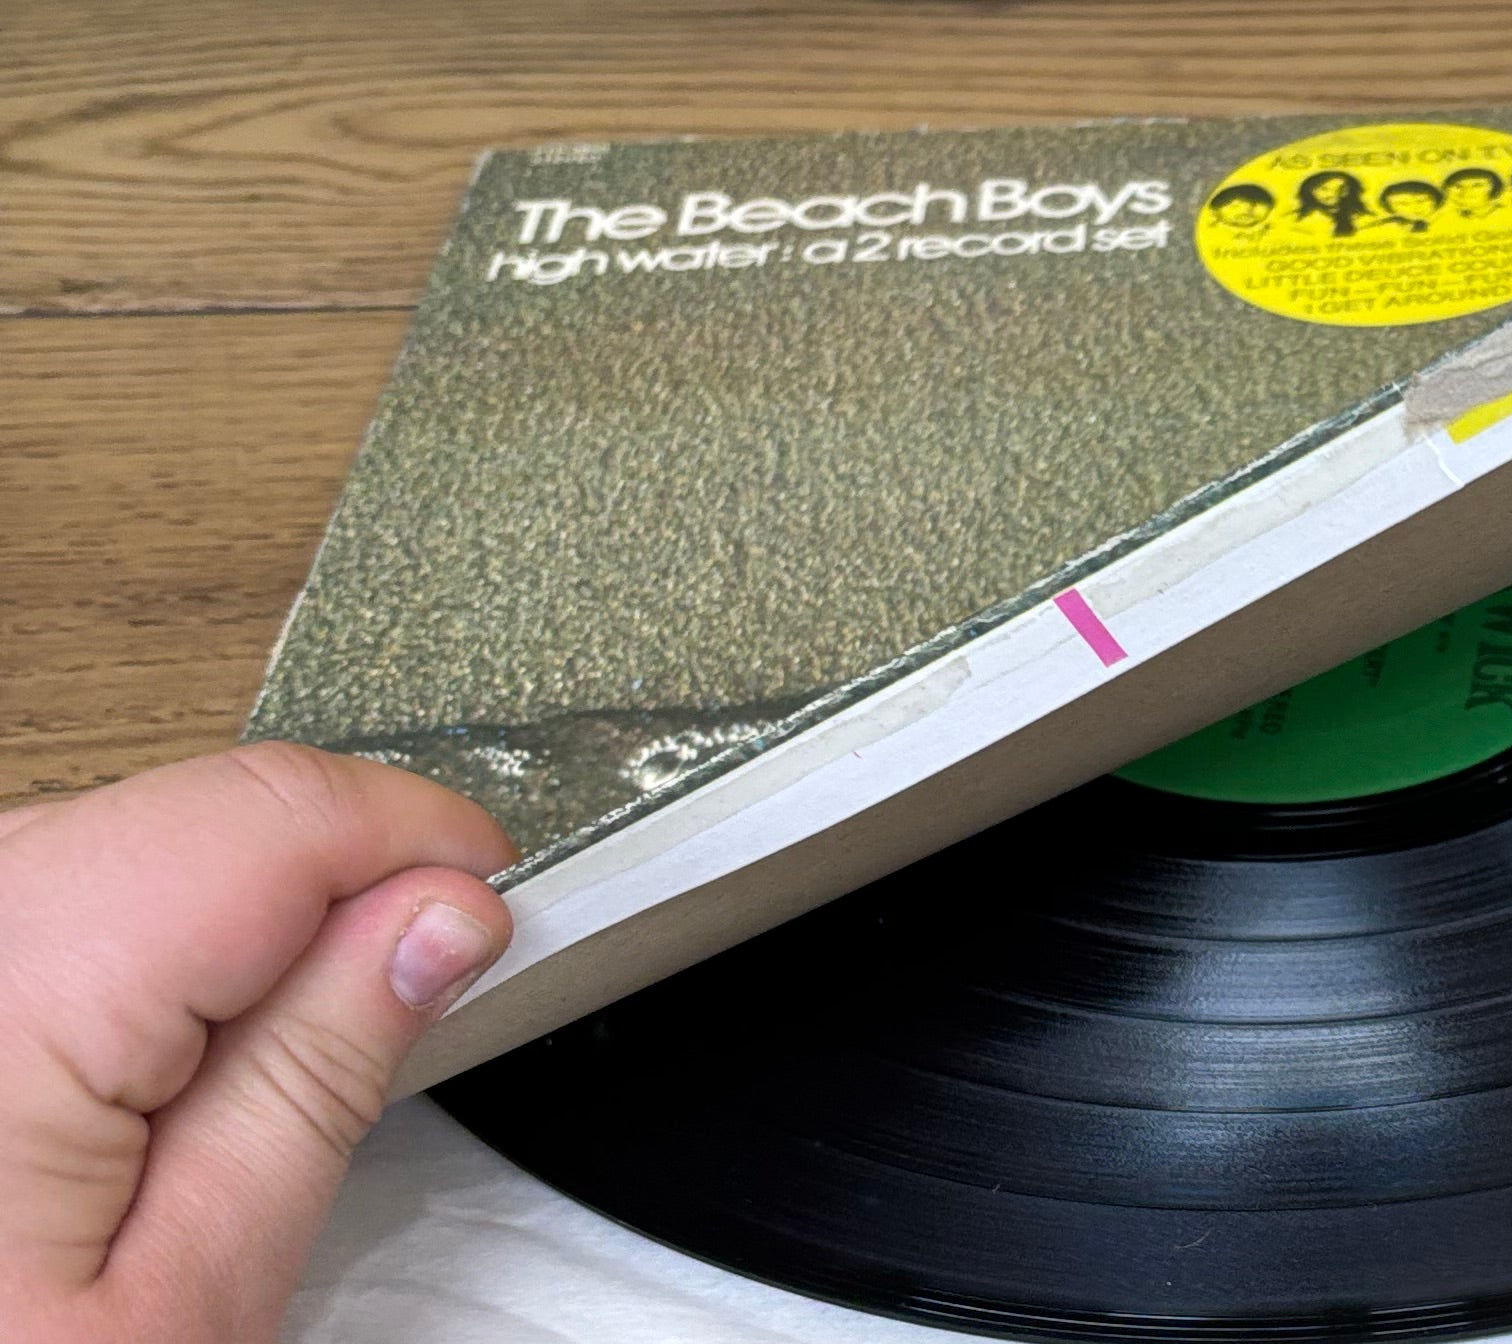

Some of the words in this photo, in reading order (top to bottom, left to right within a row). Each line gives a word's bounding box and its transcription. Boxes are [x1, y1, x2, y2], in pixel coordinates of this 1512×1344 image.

[514, 198, 668, 244] The
[677, 182, 968, 236] Beach
[976, 177, 1173, 226] Boys
[484, 249, 610, 286] high
[801, 239, 849, 265] a
[852, 230, 893, 263] 2
[896, 223, 1087, 262] record
[1092, 219, 1173, 253] set
